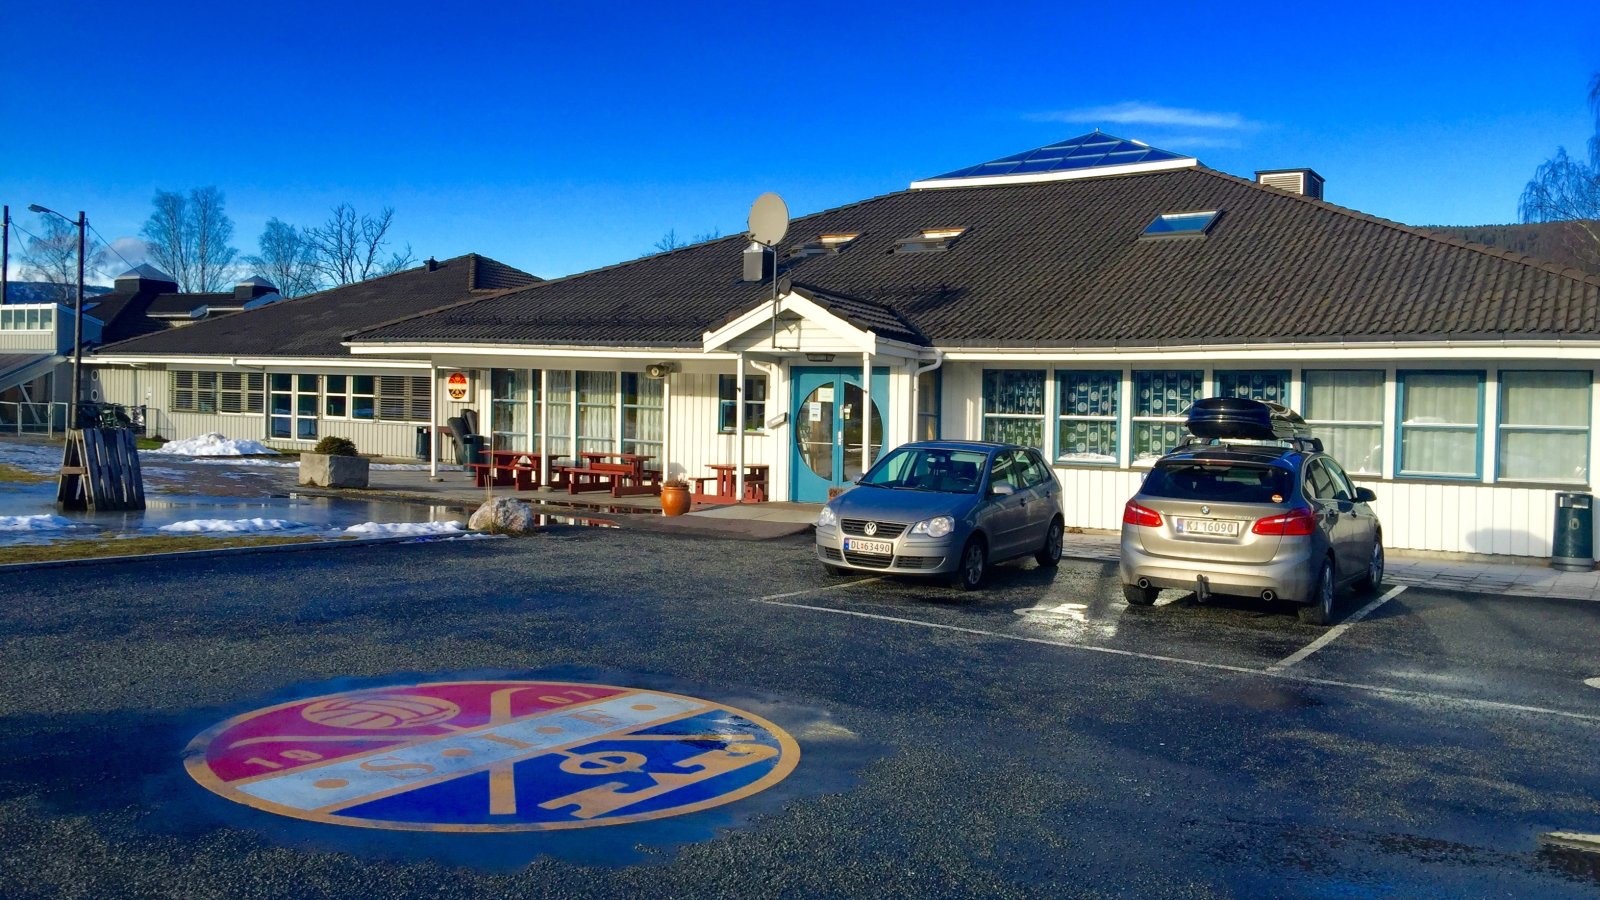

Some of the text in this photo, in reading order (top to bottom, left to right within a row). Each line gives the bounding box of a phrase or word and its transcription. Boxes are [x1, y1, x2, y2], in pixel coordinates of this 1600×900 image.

[1186, 520, 1234, 533] KJ 16090
[851, 541, 890, 552] DL 63490
[243, 749, 324, 769] 19
